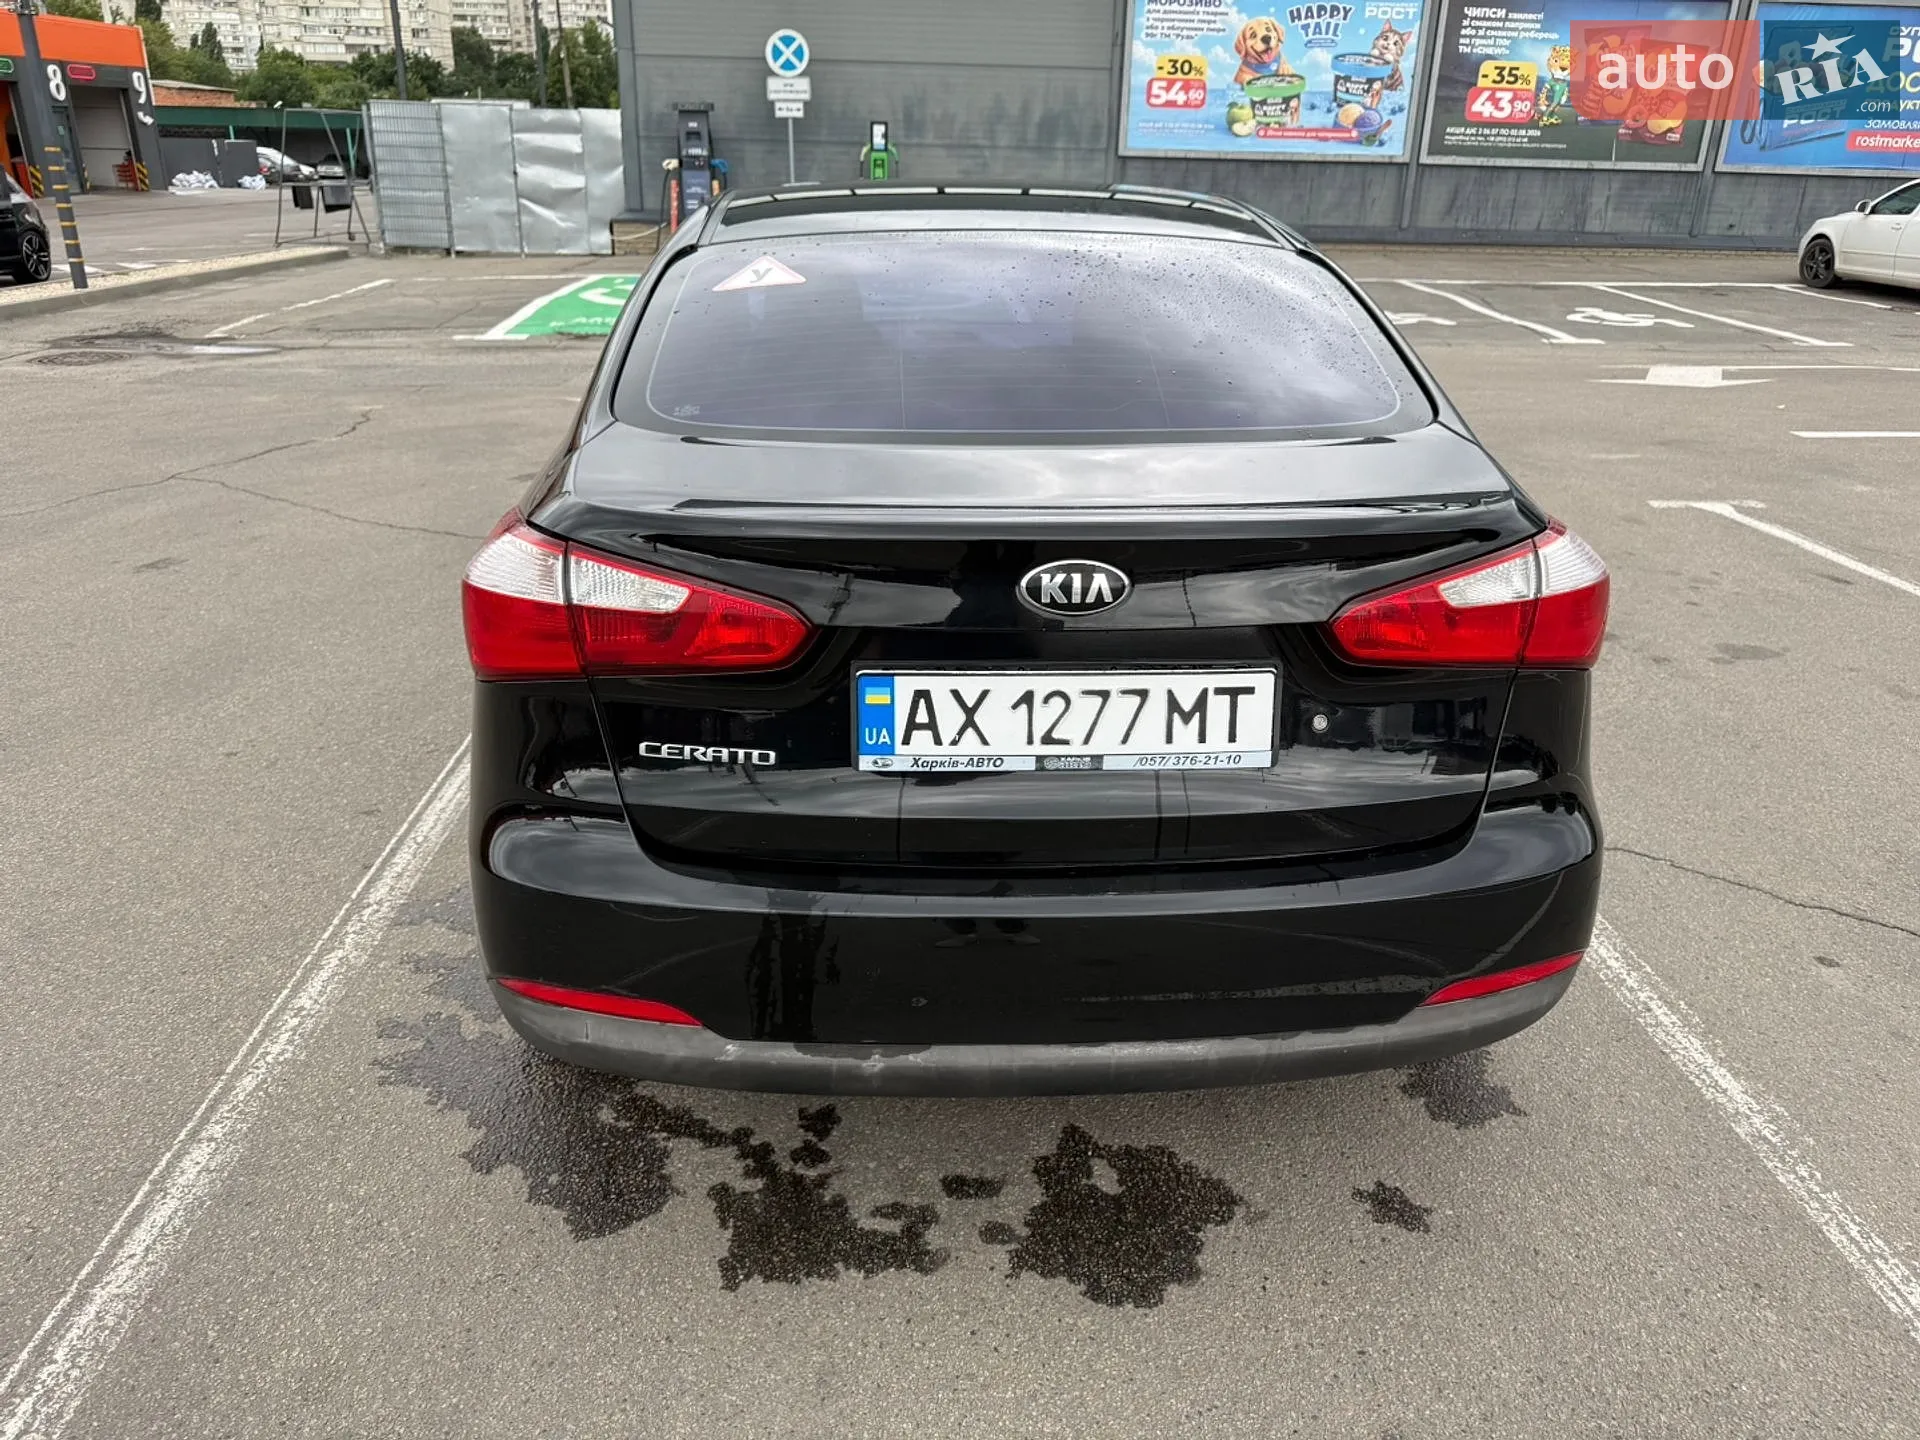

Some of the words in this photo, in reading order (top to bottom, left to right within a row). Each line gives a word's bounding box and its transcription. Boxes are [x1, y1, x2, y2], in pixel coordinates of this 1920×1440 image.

[1288, 4, 1352, 23] HAPPY
[1364, 6, 1418, 19] РОСТ
[1463, 6, 1507, 19] ЧИПСИ
[1301, 21, 1342, 37] TAIL
[1460, 27, 1476, 36] або
[1486, 29, 1519, 38] смаком
[1470, 20, 1504, 28] смаком
[1458, 45, 1471, 53] ТМ
[47, 64, 66, 101] 8
[132, 71, 147, 104] 9
[1148, 79, 1188, 106] 54
[1471, 90, 1514, 119] 43
[1513, 100, 1531, 113] 90
[1040, 573, 1114, 604] KIA
[901, 688, 991, 746] AX
[1011, 688, 1150, 746] 1277
[1165, 686, 1256, 744] MT
[865, 727, 891, 745] UA
[638, 741, 776, 766] CERATO
[909, 756, 1005, 770] Харків-АВТО
[1171, 754, 1243, 767] 376-21-10
